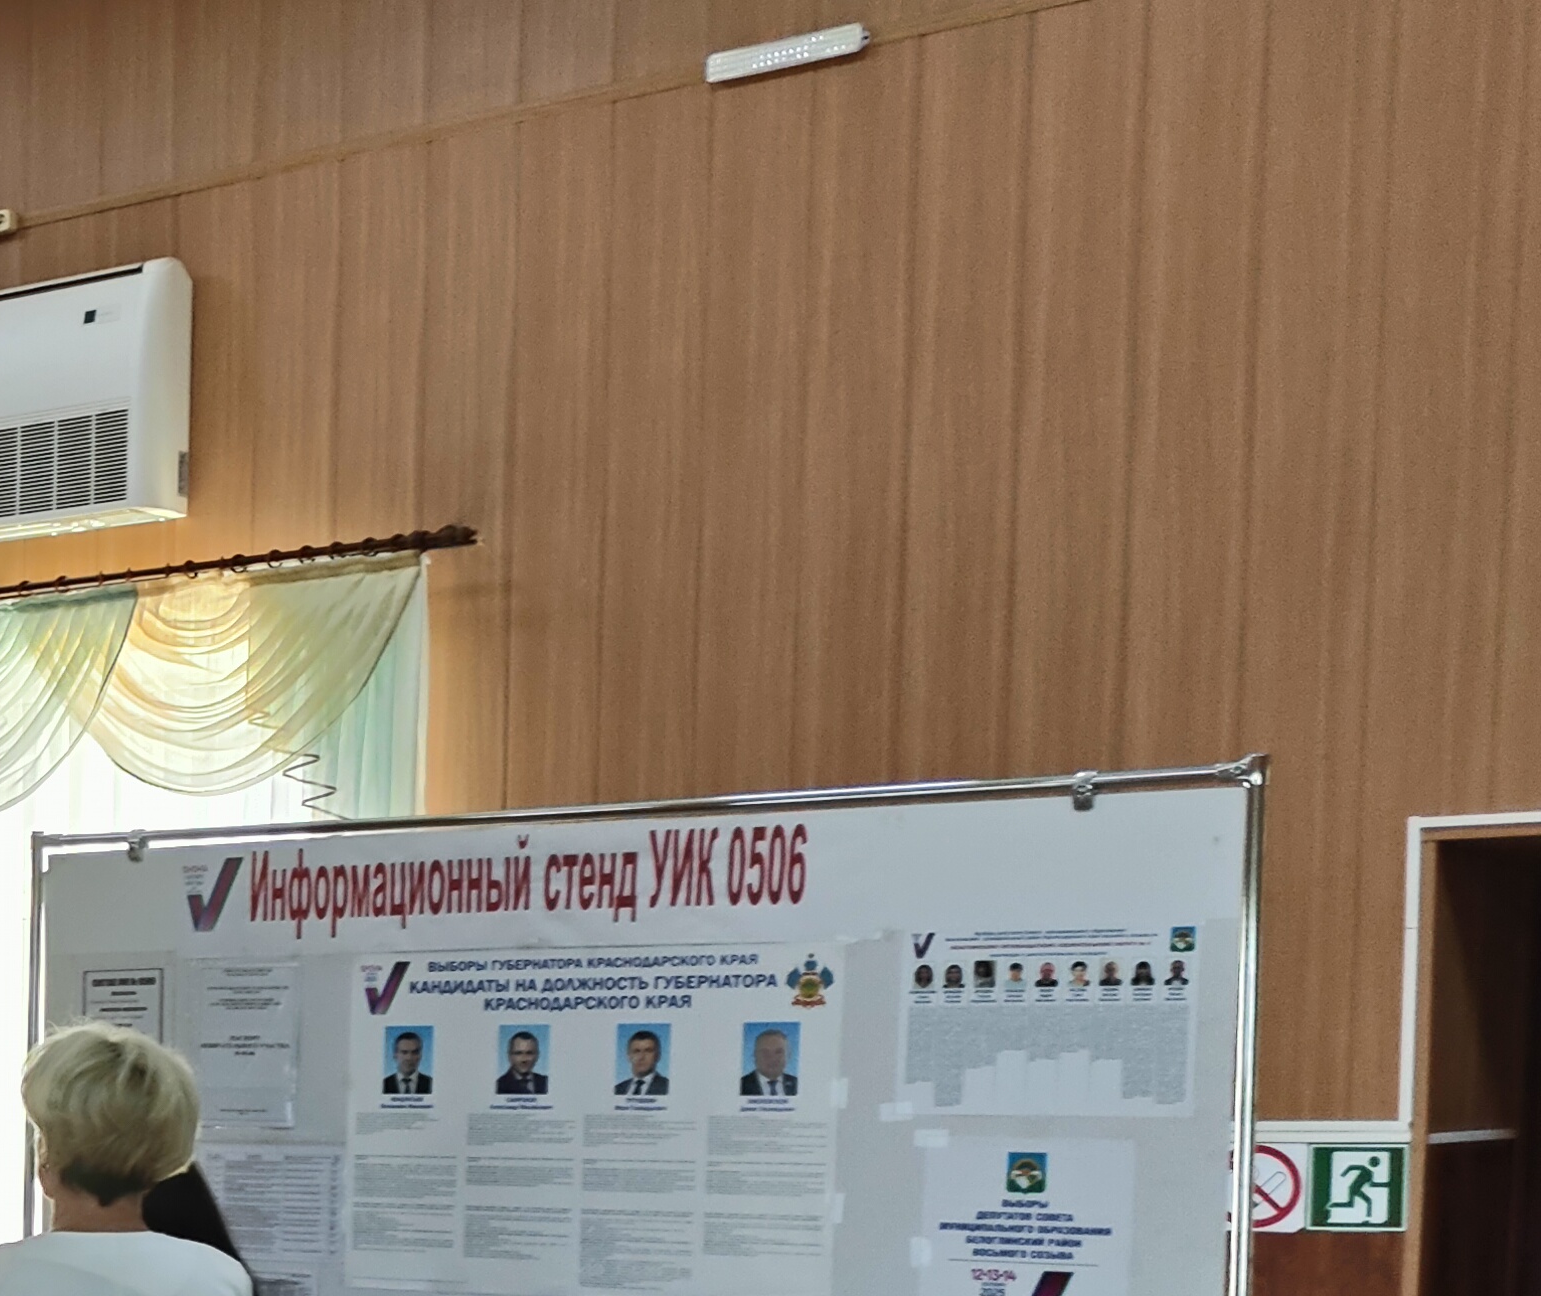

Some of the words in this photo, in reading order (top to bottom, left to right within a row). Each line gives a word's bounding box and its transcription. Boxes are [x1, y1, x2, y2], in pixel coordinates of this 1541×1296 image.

[249, 833, 532, 939] Информационный
[545, 851, 639, 922] стенд
[648, 828, 719, 908] УИК
[728, 823, 808, 906] 0506
[427, 960, 488, 973] ВЫБОРЫ
[491, 957, 584, 971] ГУБЕРНАТОРА
[587, 954, 716, 969] КРАСНОДАРСКОГО
[719, 954, 759, 966] КРАЯ
[409, 978, 510, 995] КАНДИДАТЫ
[516, 978, 537, 993] НА
[541, 975, 649, 993] ДОЛЖНОСТЬ
[653, 973, 778, 991] ГУБЕРНАТОРА
[483, 995, 641, 1012] КРАСНОДАРСКОГО
[644, 994, 693, 1009] КРАЯ
